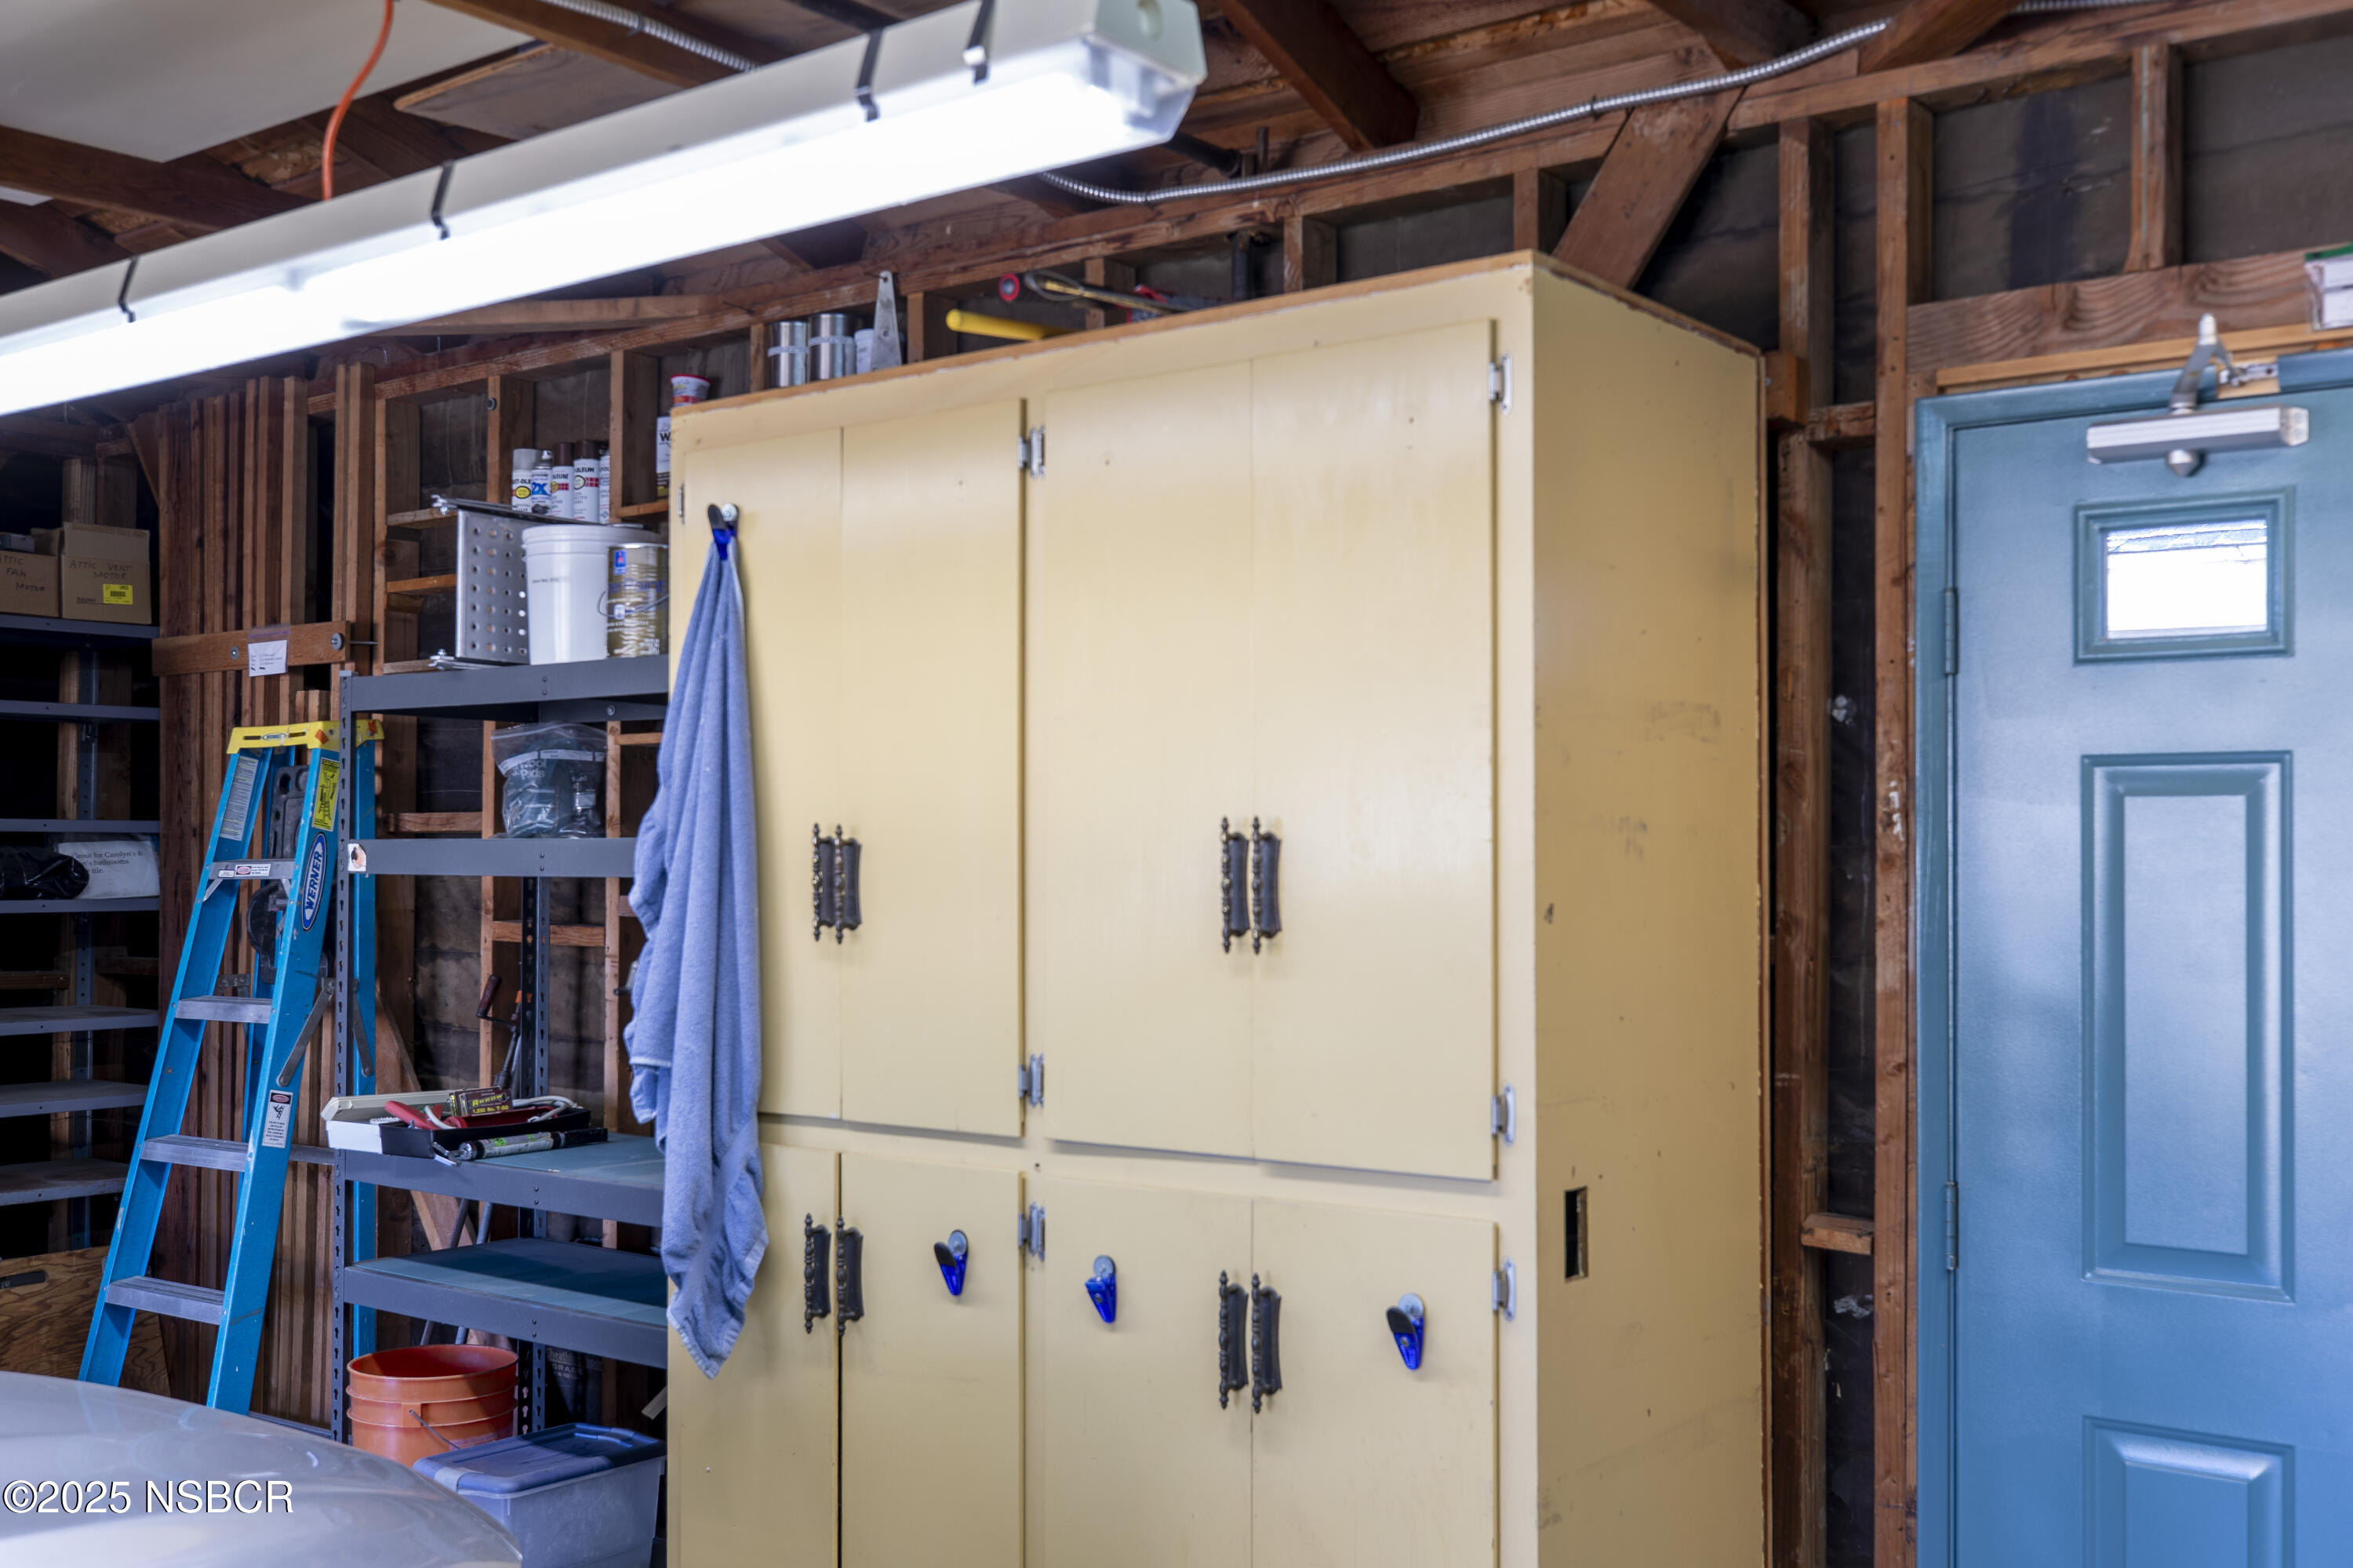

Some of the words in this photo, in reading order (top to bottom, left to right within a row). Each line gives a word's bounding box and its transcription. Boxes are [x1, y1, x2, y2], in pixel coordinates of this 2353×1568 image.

[69, 560, 96, 569] ATTIC
[6, 567, 26, 577] FAN
[93, 571, 126, 580] MOTOR
[305, 851, 322, 910] WERNER
